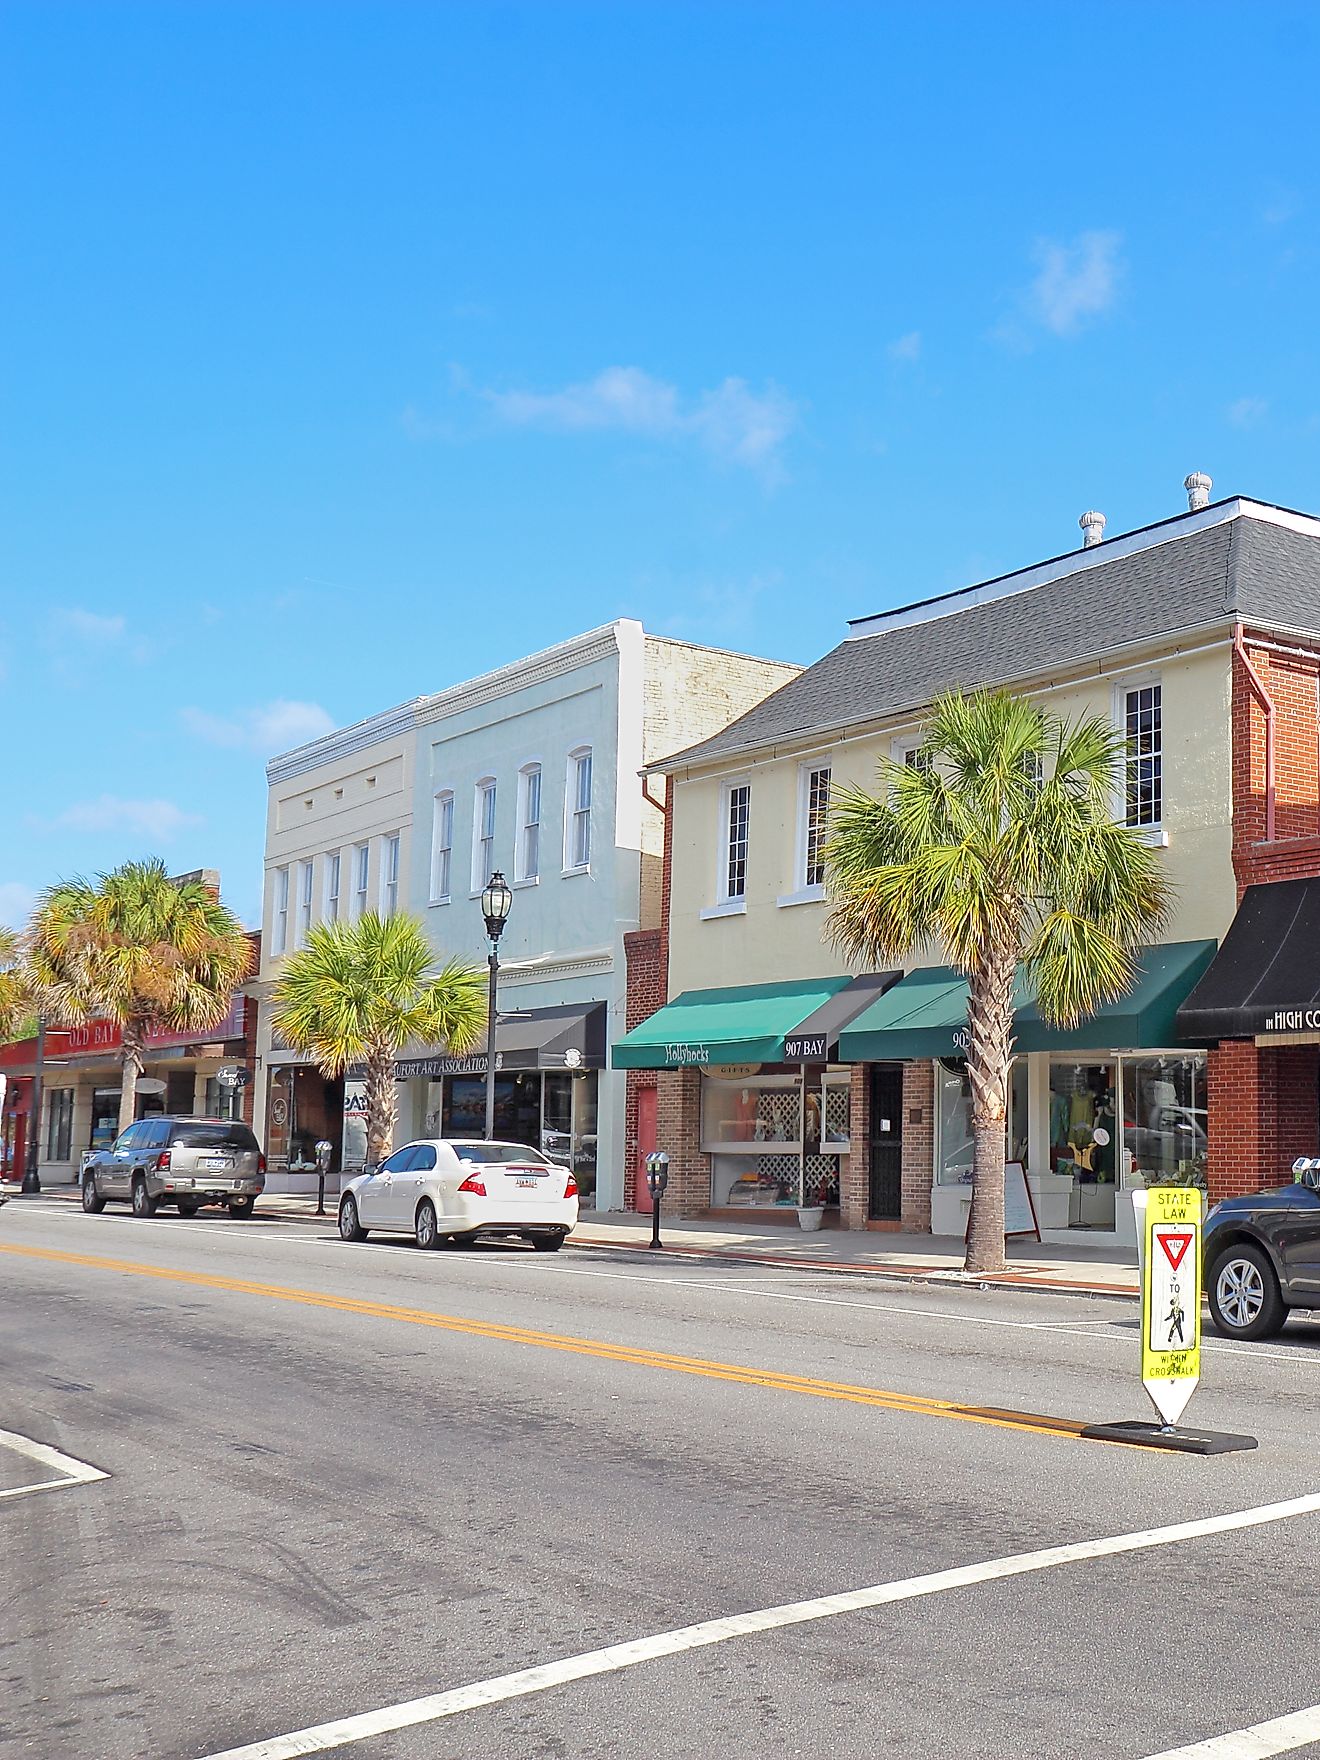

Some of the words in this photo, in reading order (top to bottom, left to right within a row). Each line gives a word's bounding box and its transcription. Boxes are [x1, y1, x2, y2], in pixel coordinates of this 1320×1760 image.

[1265, 1018, 1274, 1030] IN
[1274, 1010, 1303, 1029] HIGH
[69, 1028, 89, 1047] OLD
[94, 1024, 115, 1044] BAY
[665, 1043, 709, 1064] Hollyhocks
[785, 1042, 801, 1057] 907
[803, 1039, 825, 1056] BAY
[422, 1061, 440, 1074] ART
[228, 1077, 246, 1086] BAY
[1158, 1193, 1191, 1205] STATE
[1163, 1208, 1187, 1220] LAW
[1169, 1283, 1180, 1293] TO
